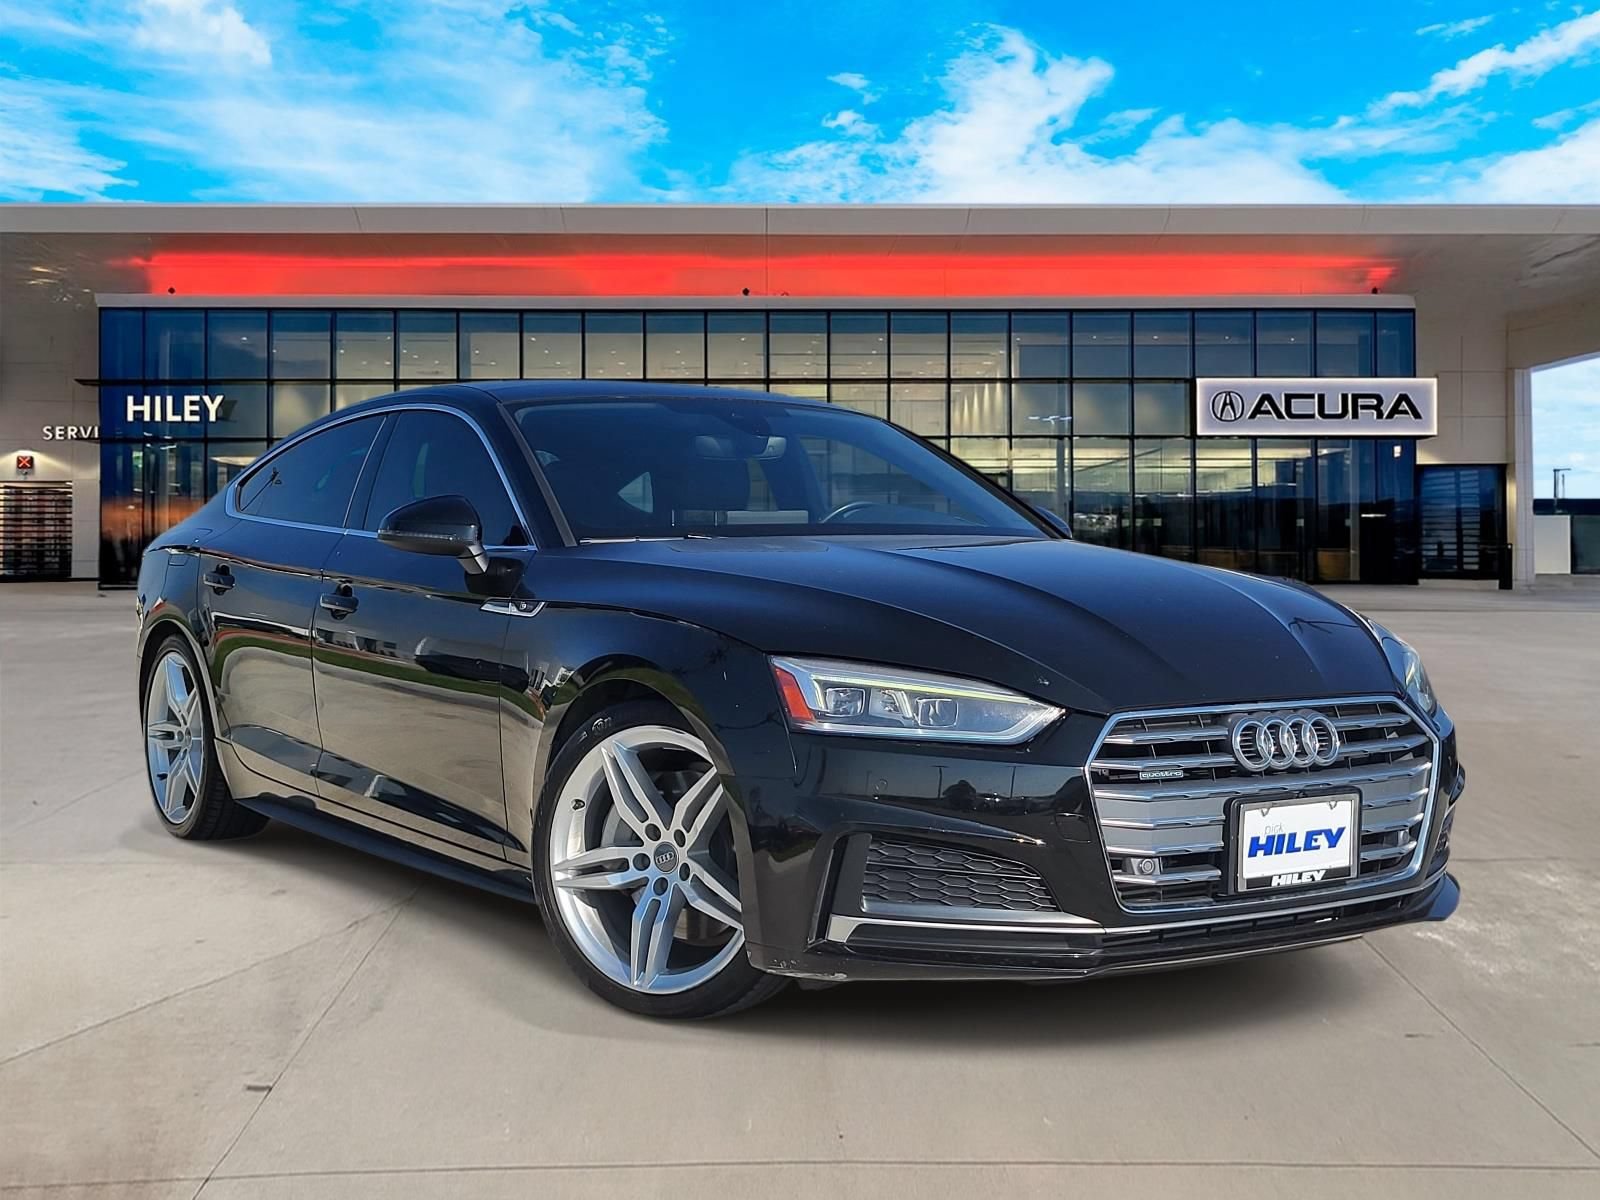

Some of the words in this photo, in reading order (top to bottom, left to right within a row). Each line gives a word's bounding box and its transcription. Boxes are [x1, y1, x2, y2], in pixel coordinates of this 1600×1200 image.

[126, 395, 224, 422] HILEY
[1249, 393, 1422, 420] ACURA
[1141, 770, 1183, 779] quattro
[1248, 826, 1346, 858] HILEY
[1271, 869, 1327, 887] HILEY
